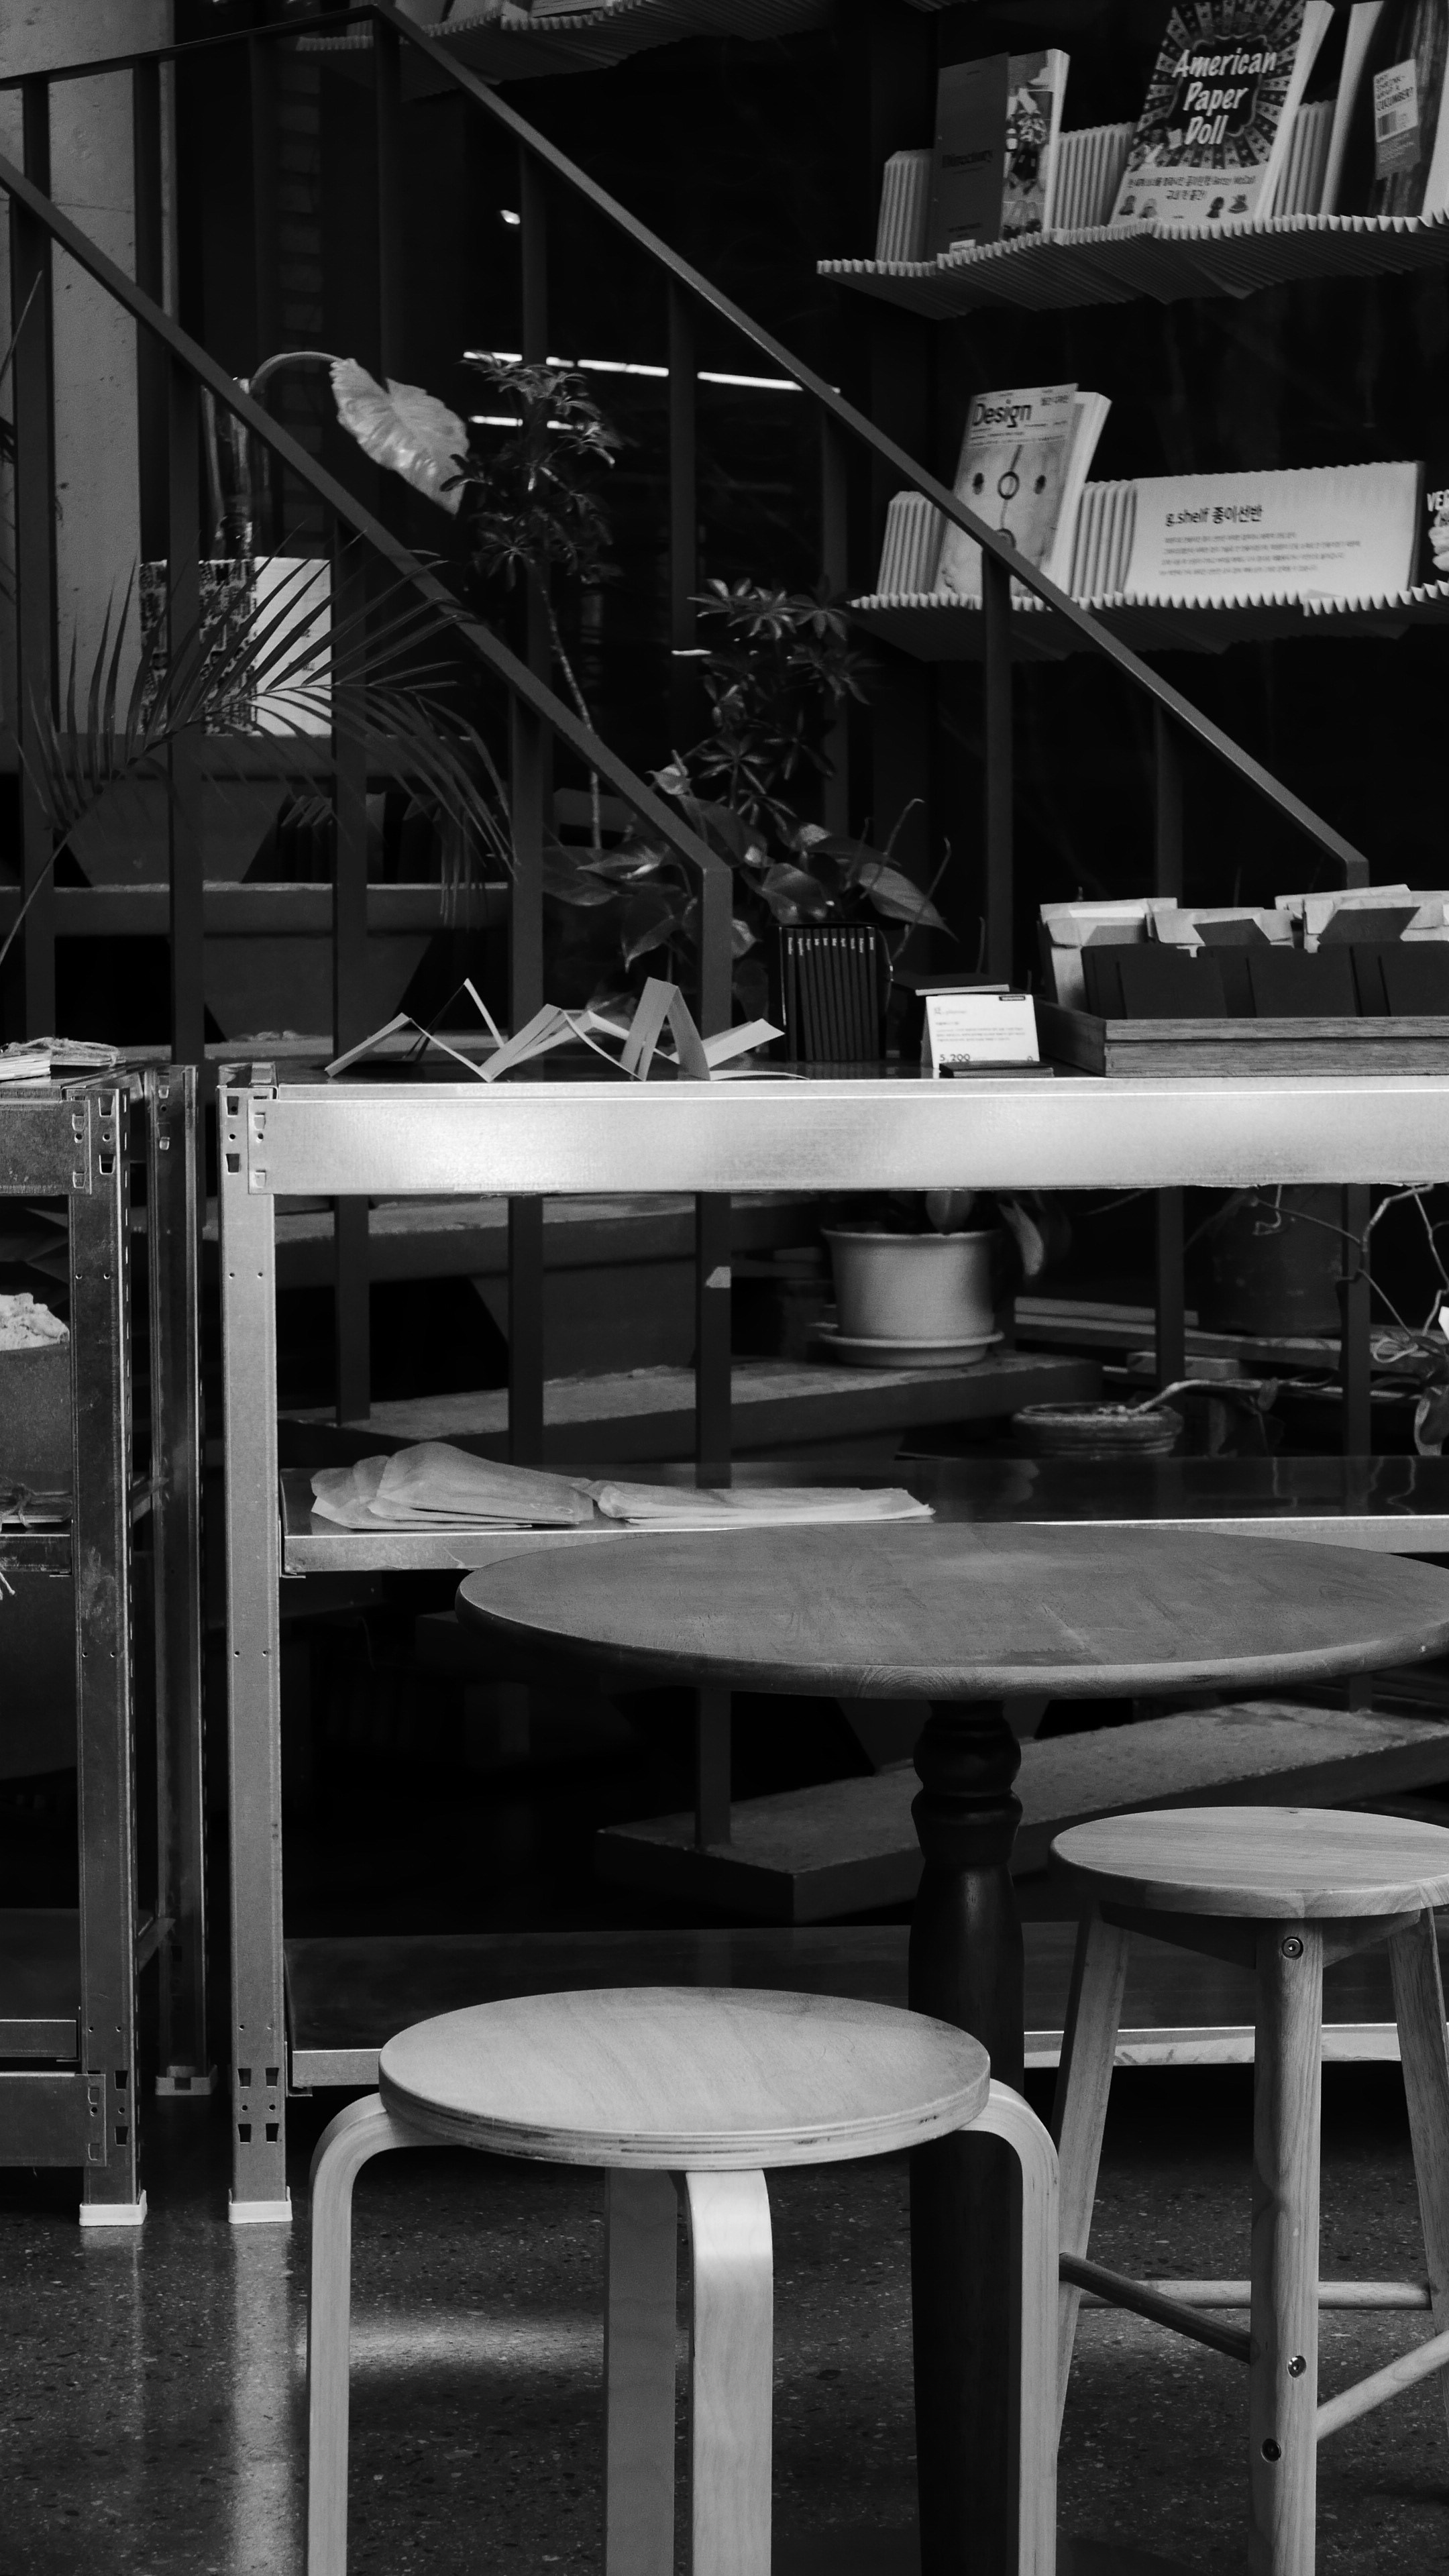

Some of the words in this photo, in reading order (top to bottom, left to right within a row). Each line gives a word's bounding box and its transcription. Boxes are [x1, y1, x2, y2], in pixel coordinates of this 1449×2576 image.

[1171, 47, 1277, 78] American
[1182, 81, 1249, 117] Paper
[1185, 115, 1229, 145] Doll
[973, 399, 1032, 428] Design
[1212, 504, 1264, 524] 종이선반
